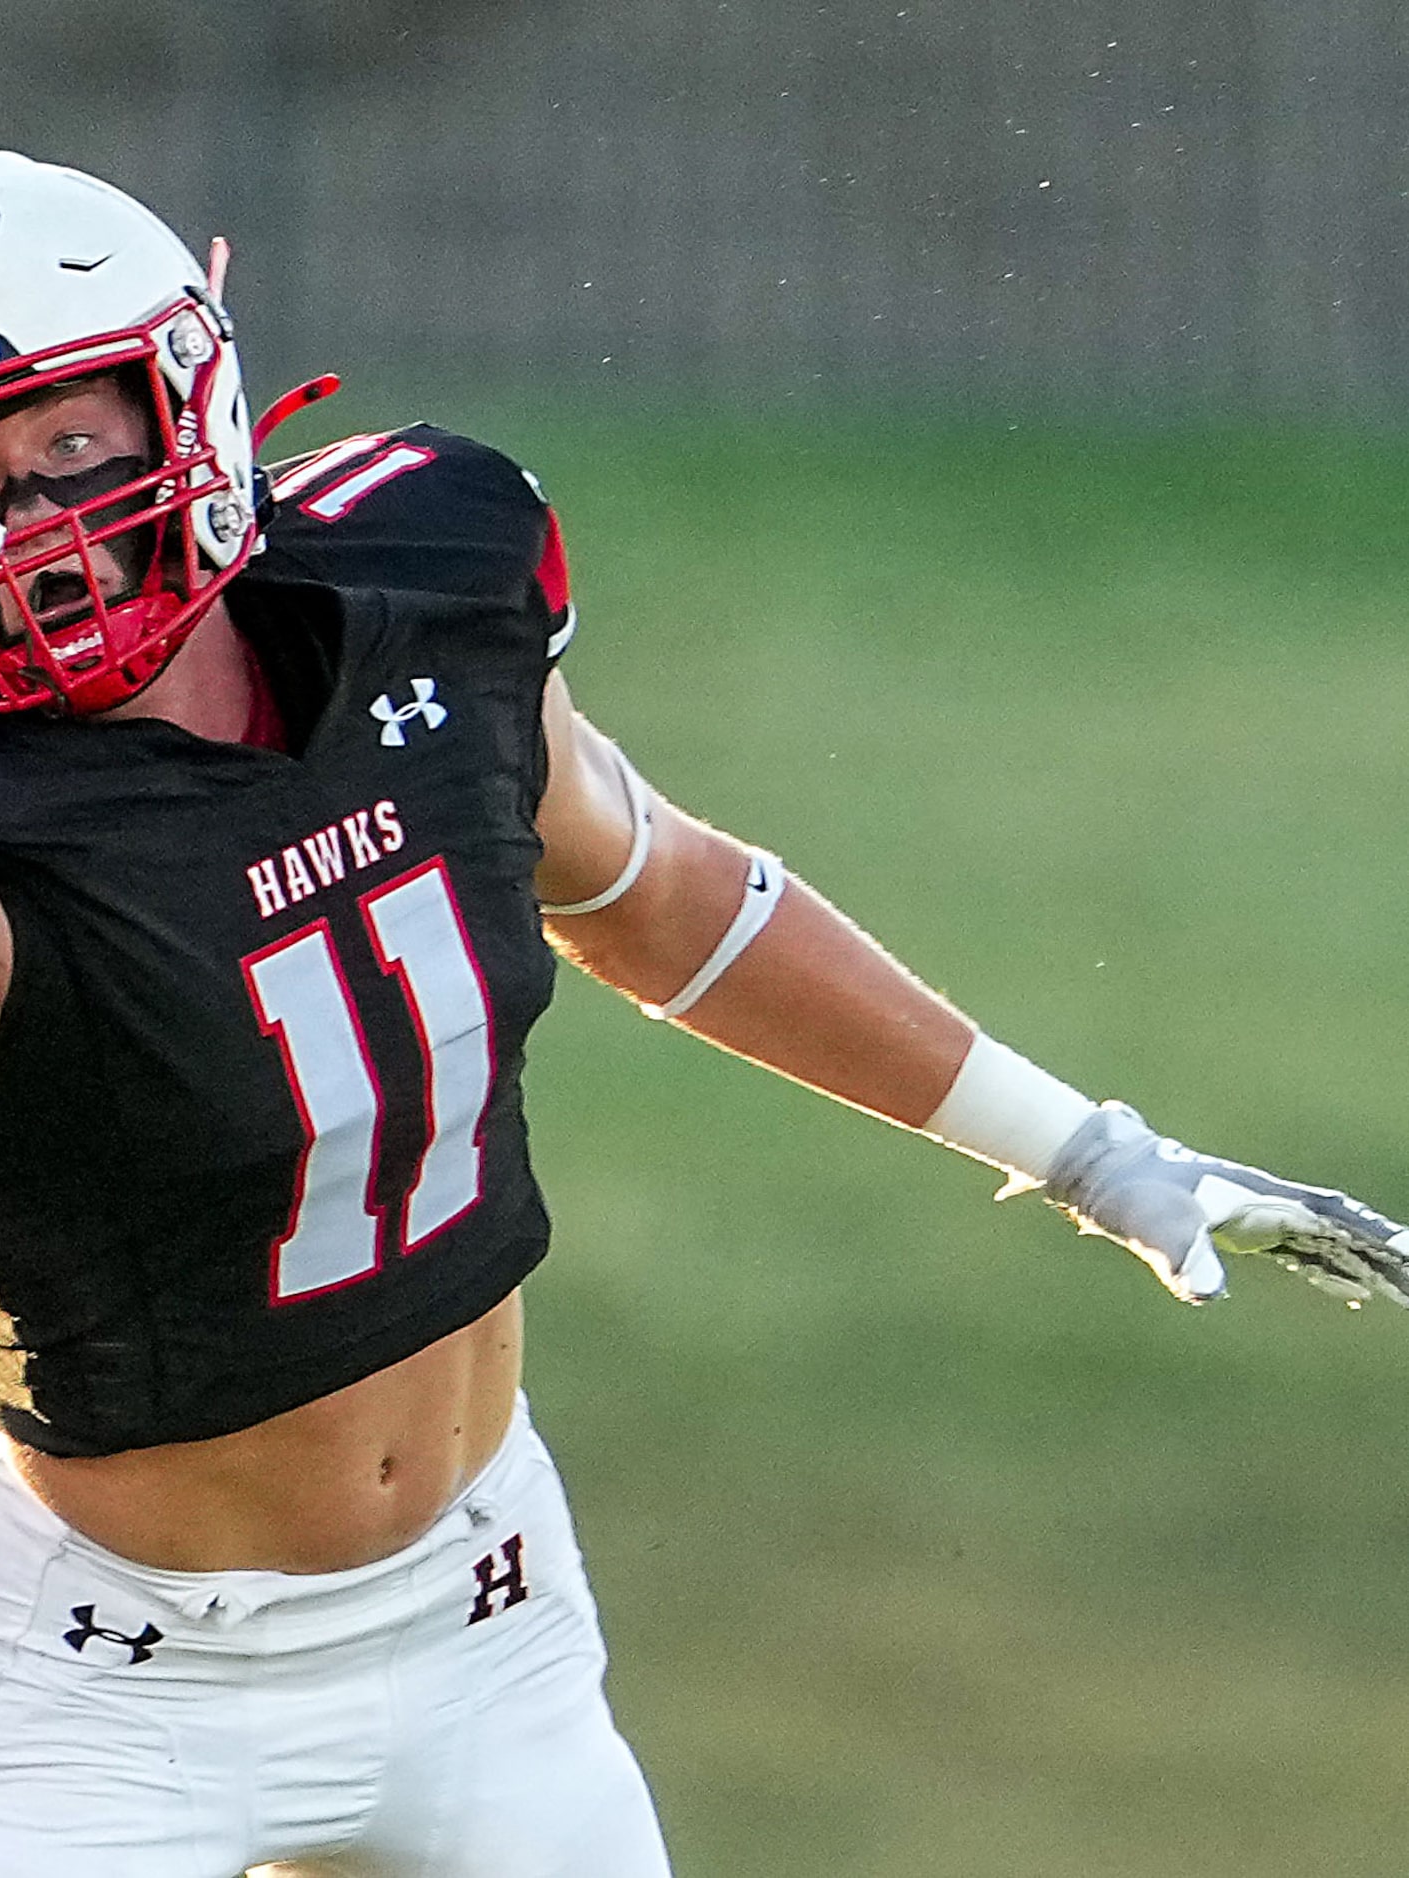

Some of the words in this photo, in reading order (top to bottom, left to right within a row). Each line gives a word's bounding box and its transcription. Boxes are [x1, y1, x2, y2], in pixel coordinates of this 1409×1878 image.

[246, 799, 406, 919] HAWKS
[239, 854, 498, 1307] 11
[464, 1532, 528, 1628] H
